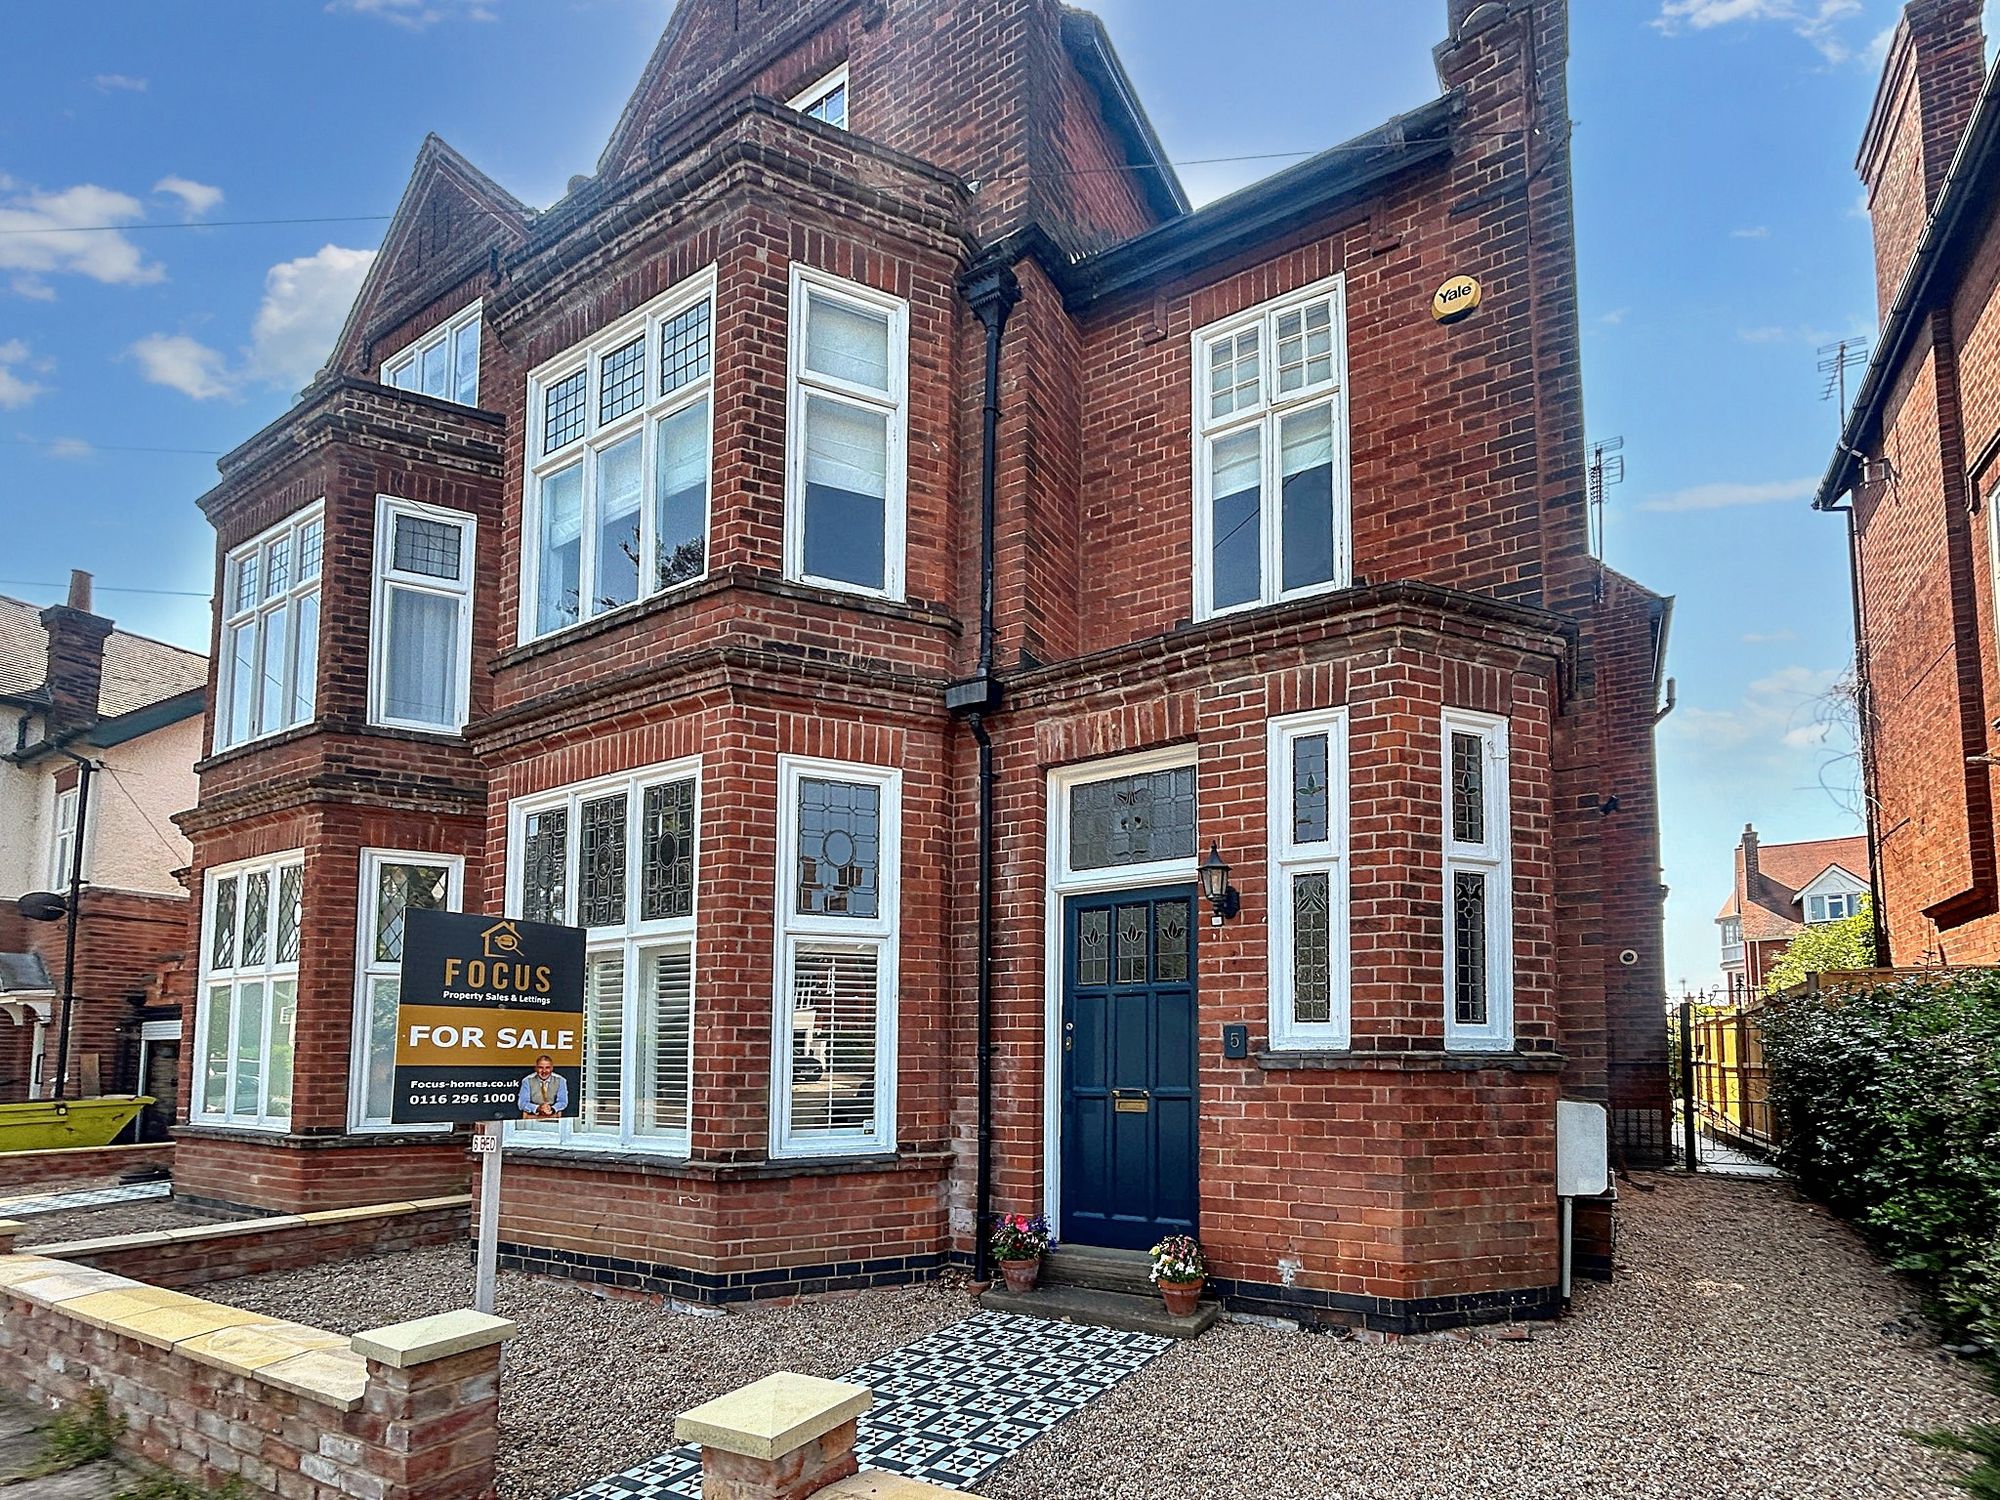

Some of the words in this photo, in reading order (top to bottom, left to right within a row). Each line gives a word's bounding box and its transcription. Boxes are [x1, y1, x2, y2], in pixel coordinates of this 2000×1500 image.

[1439, 286, 1471, 303] Yale
[445, 959, 550, 992] FOCUS
[443, 991, 483, 1002] Property
[486, 993, 508, 1002] Sales
[511, 994, 517, 1002] &
[520, 995, 550, 1005] Lettings
[409, 1025, 485, 1048] FOR
[497, 1029, 574, 1049] SALE
[1230, 1033, 1240, 1048] 5
[411, 1080, 519, 1088] Focus-homes.co.uk
[410, 1095, 447, 1105] 0116
[452, 1094, 479, 1103] 296
[483, 1094, 515, 1103] 1000
